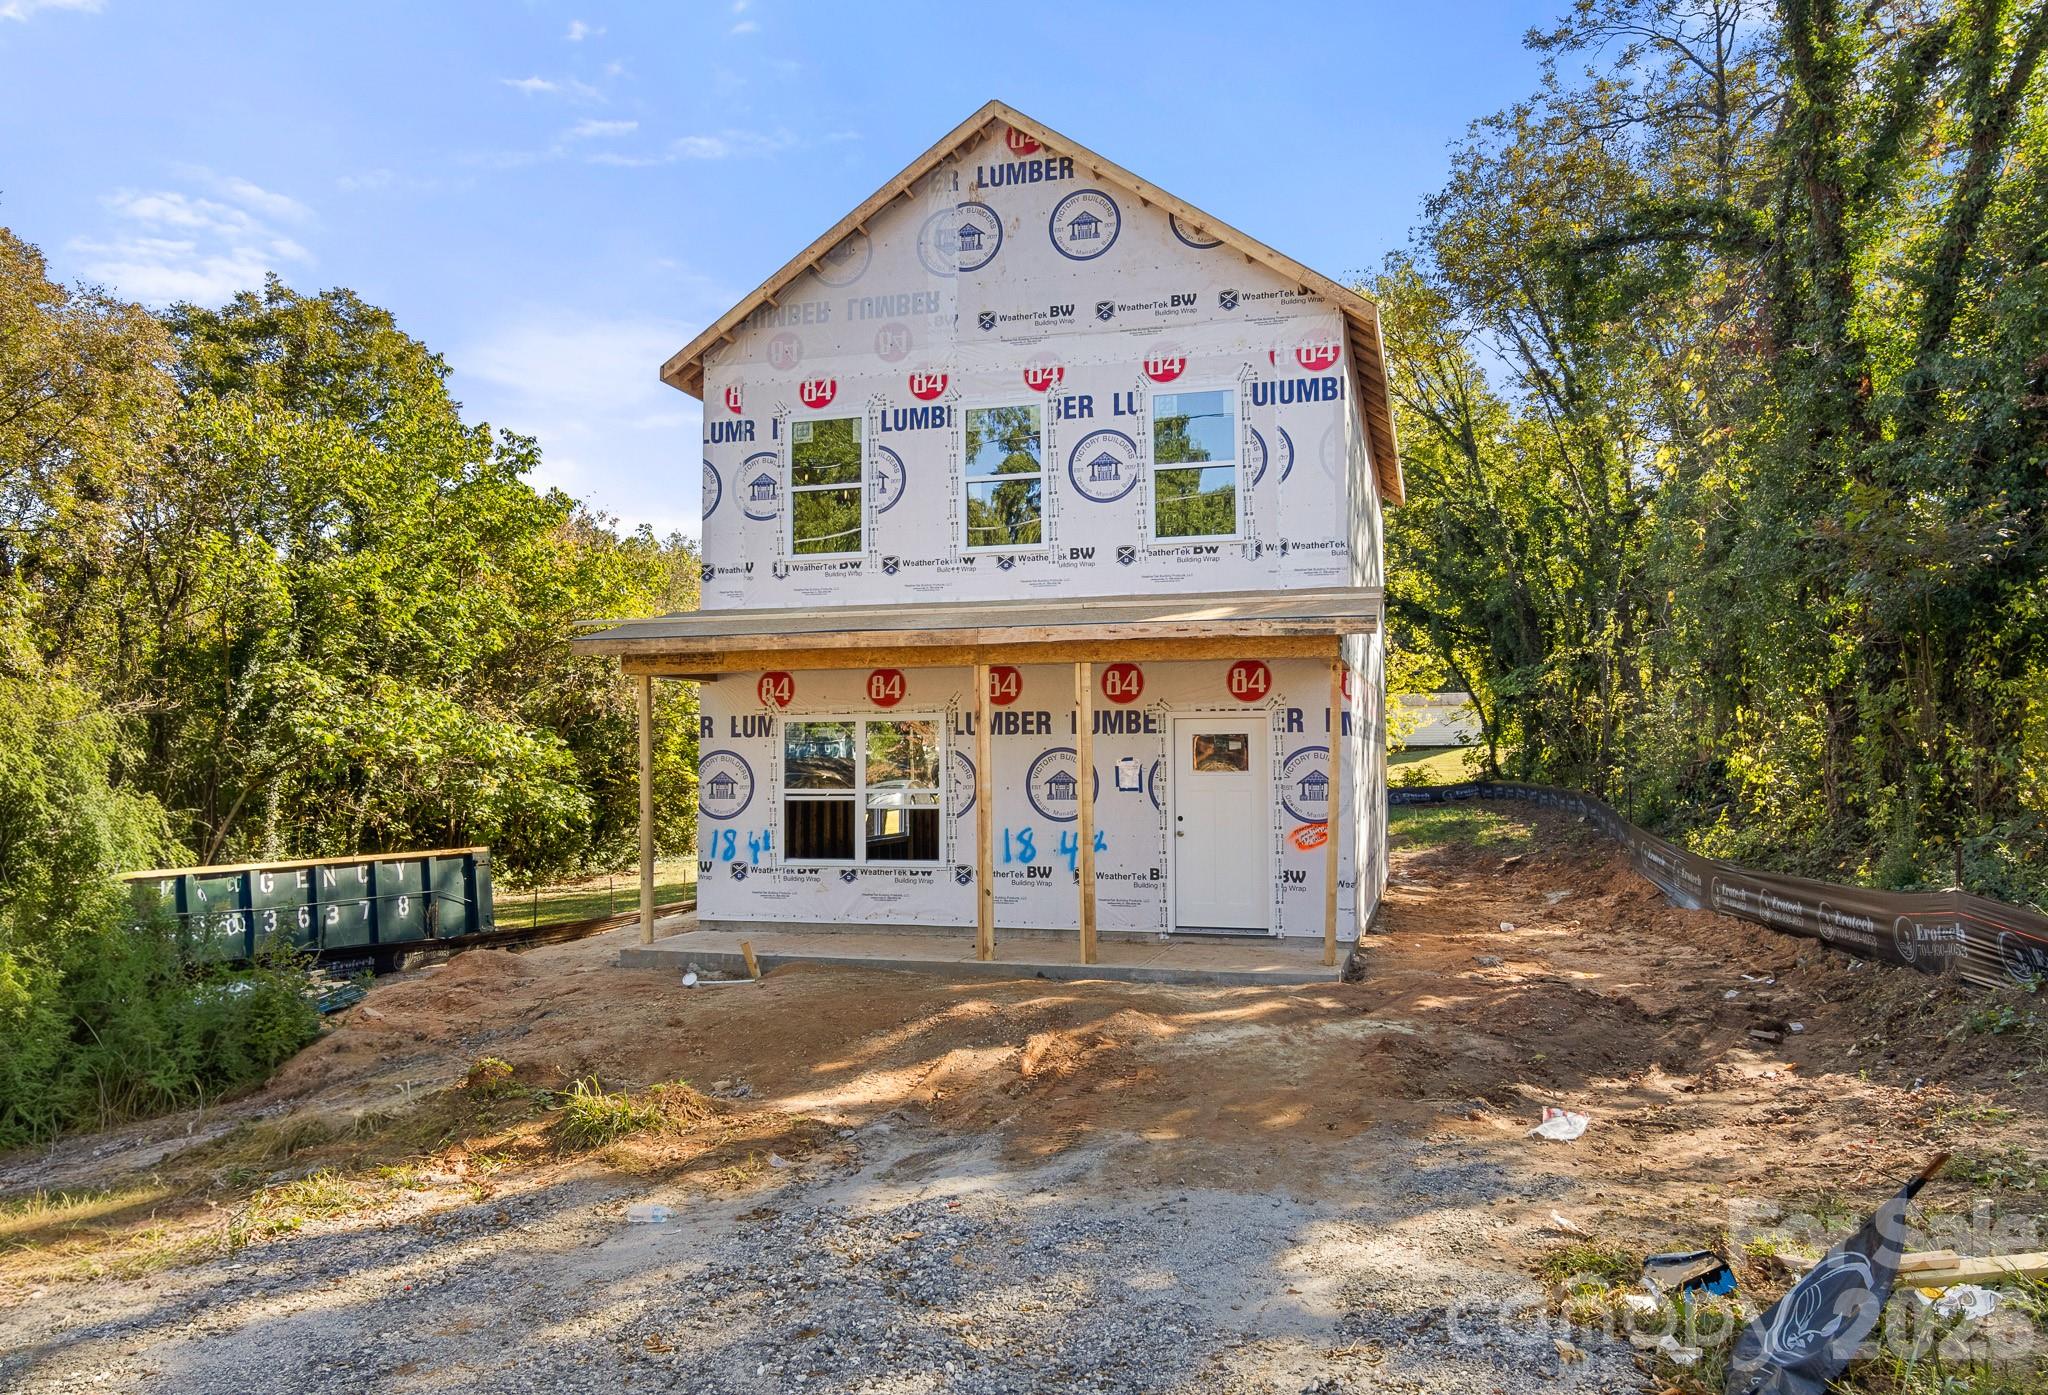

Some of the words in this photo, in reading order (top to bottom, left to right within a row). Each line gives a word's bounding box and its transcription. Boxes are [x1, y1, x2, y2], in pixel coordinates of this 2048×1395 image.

[977, 156, 1075, 189] LUMBER
[1241, 290, 1295, 301] WeatherTek
[1117, 300, 1168, 312] WeatherTek
[1170, 293, 1197, 307] BW
[1280, 298, 1307, 306] Building
[999, 311, 1048, 322] WeatherTek
[1049, 304, 1075, 317] BW
[1154, 308, 1179, 317] Building
[1180, 307, 1198, 316] Wrap
[1034, 319, 1058, 327] Building
[1058, 317, 1075, 326] Wrap
[913, 370, 944, 394] 84
[803, 376, 833, 402] 84
[1291, 541, 1346, 550] WeatherTek
[1069, 547, 1096, 560] BW
[1176, 556, 1202, 564] Building
[1202, 555, 1220, 564] Wrap
[791, 563, 837, 572] WeatherTek
[902, 558, 950, 567] WeatherTek
[1058, 560, 1078, 569] uilding
[1078, 560, 1096, 568] Wrap
[824, 570, 847, 578] Building
[870, 673, 902, 699] 84
[1106, 669, 1139, 695] 84
[1231, 667, 1266, 693] 84
[761, 677, 791, 701] 84
[710, 828, 738, 862] 18
[1003, 826, 1037, 865] 18
[1026, 866, 1053, 879] BW
[1095, 870, 1147, 880] WeatherTek
[806, 875, 821, 883] Wrap
[1011, 879, 1036, 888] Building
[1036, 880, 1053, 888] Wrap
[1133, 881, 1159, 890] Building
[1914, 921, 1967, 942] Erotech
